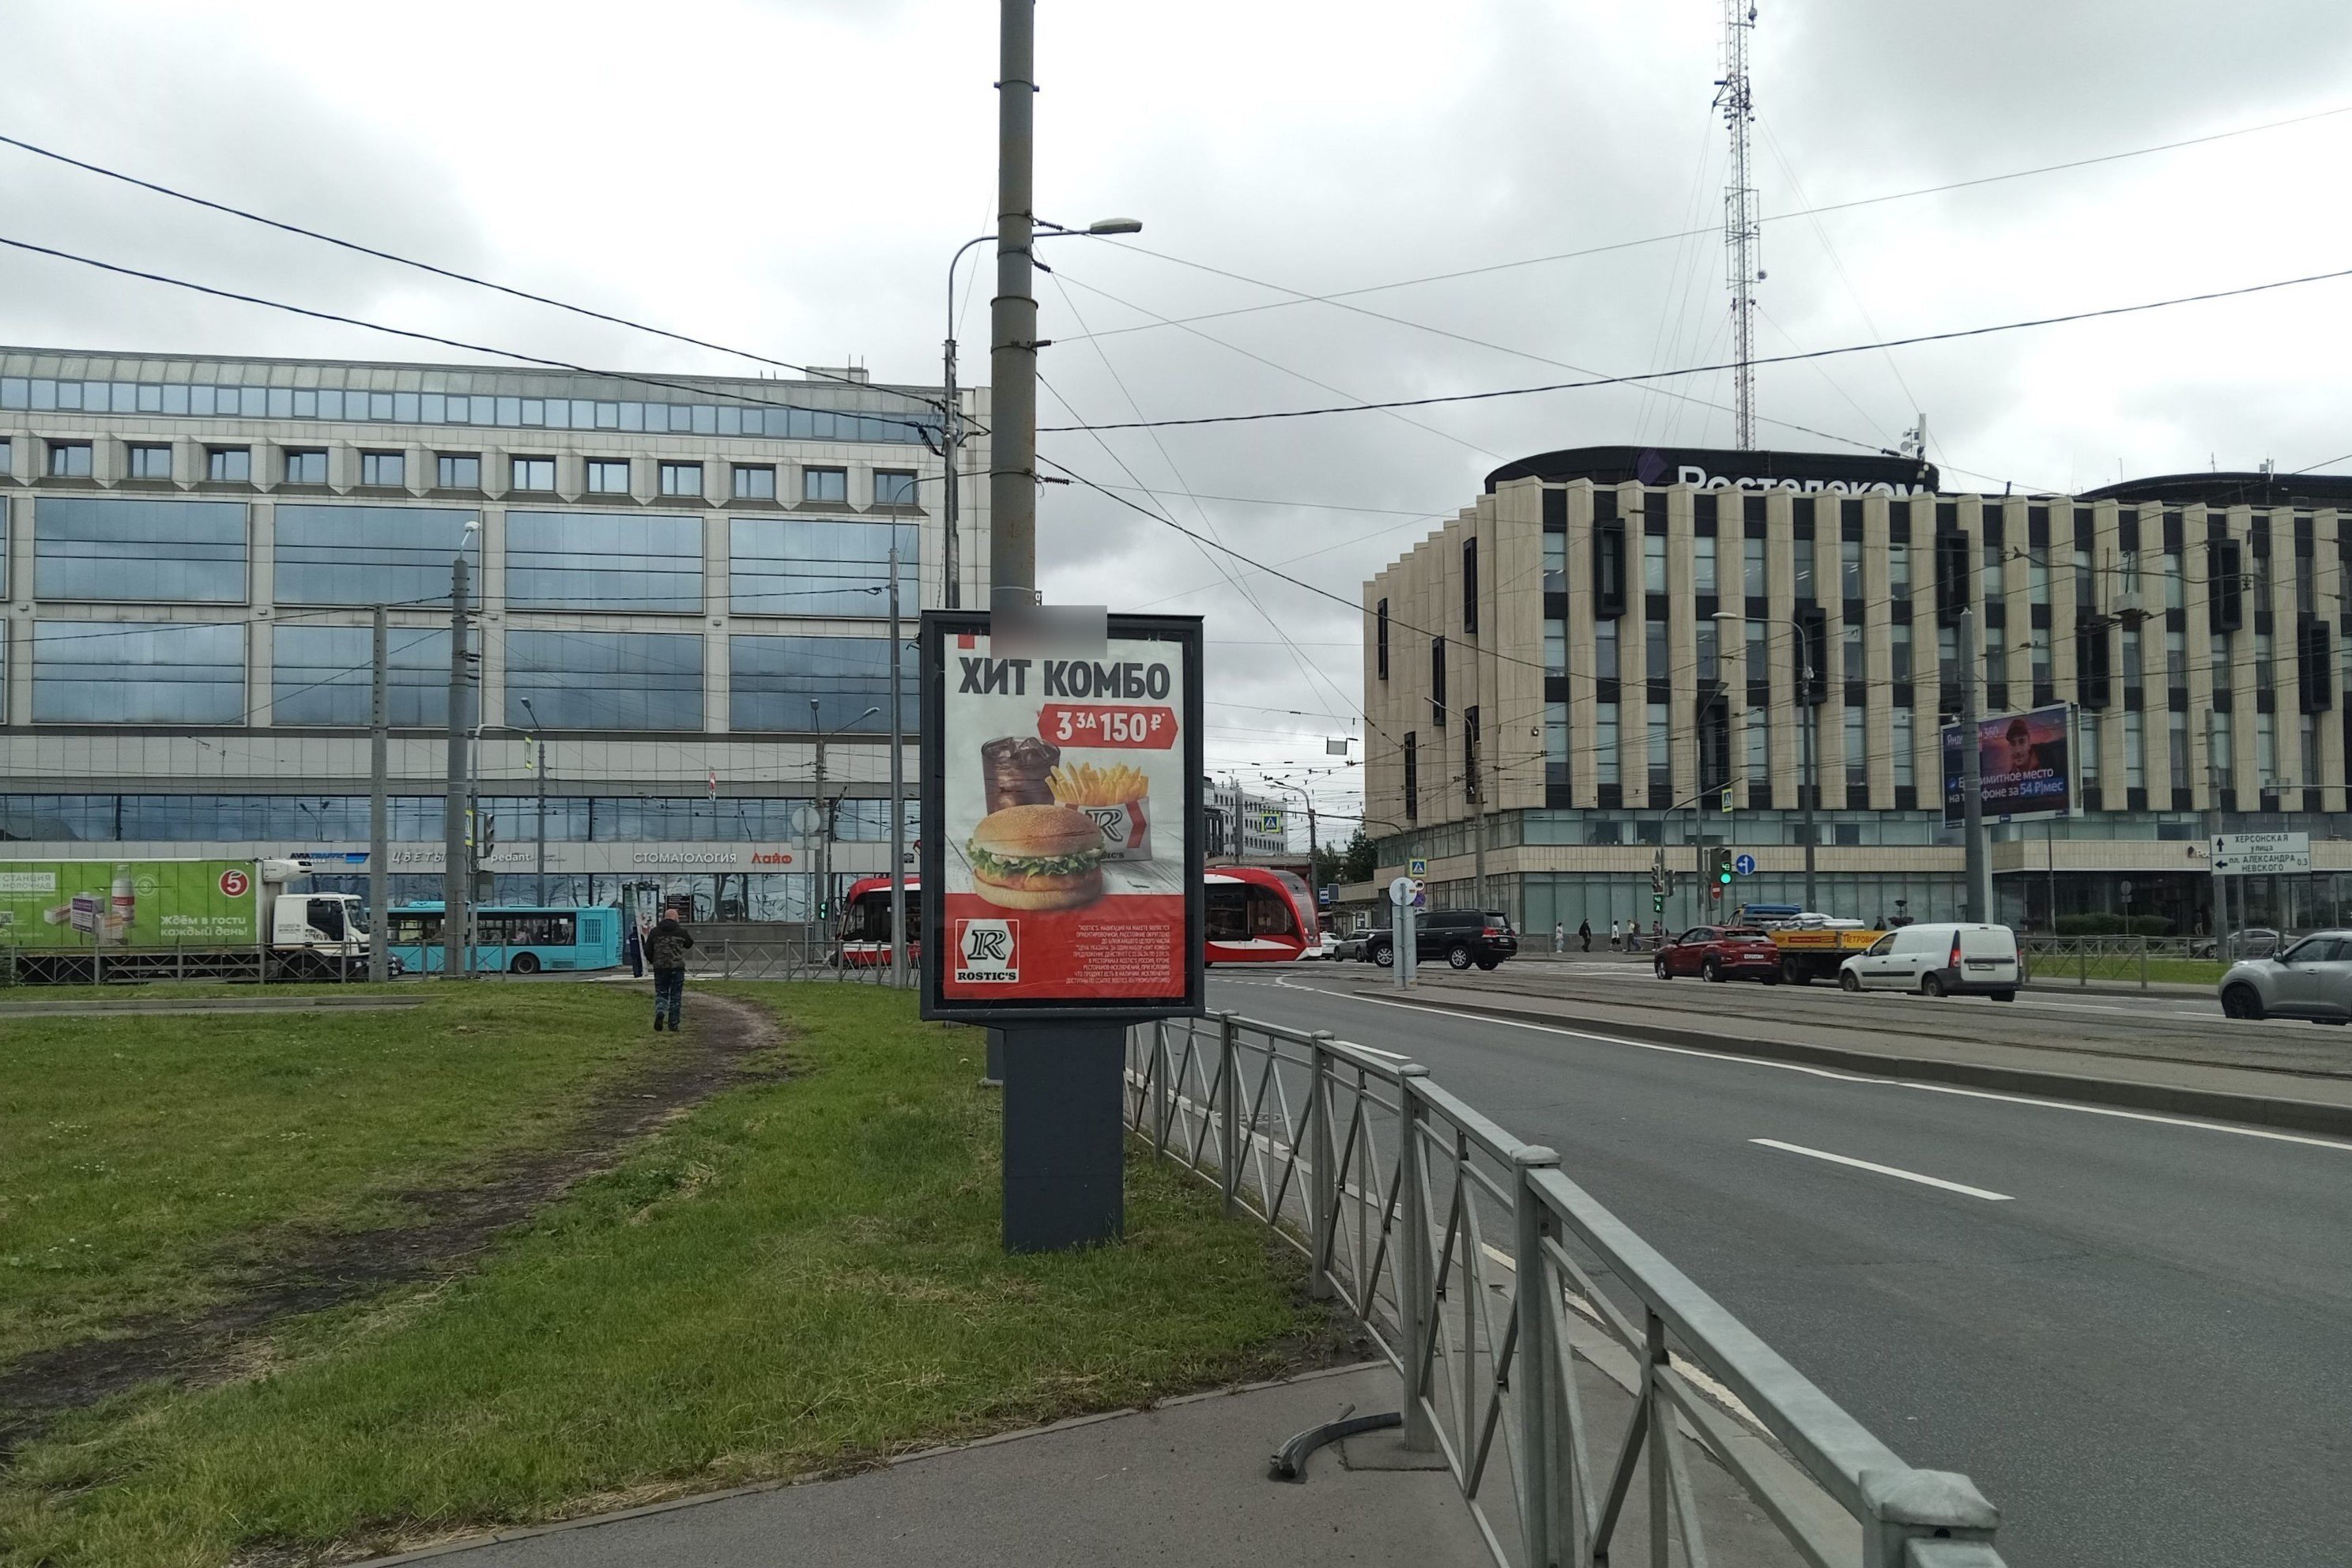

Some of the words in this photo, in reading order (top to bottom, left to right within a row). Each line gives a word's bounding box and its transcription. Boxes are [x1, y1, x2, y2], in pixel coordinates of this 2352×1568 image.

[959, 657, 1031, 695] ХИТ
[1044, 660, 1170, 699] КОМБО
[1056, 711, 1072, 741] 3
[2023, 768, 2054, 780] место
[2008, 787, 2019, 797] за
[2020, 782, 2033, 795] 54
[2235, 835, 2289, 843] ХЕРСОНСКАЯ
[391, 852, 447, 864] ЦВЕТЫ
[491, 851, 530, 863] pedant
[633, 853, 737, 864] СТОМАТОЛОГИЯ
[752, 852, 793, 864] Лайф
[2243, 854, 2296, 863] АЛЕКСАНДРА
[2242, 864, 2284, 873] НЕВСКОГО
[160, 915, 198, 925] Ждём
[160, 926, 213, 936] каждый
[215, 926, 248, 936] день!
[967, 929, 1006, 960] R
[957, 972, 1016, 981] ROSTIC'S
